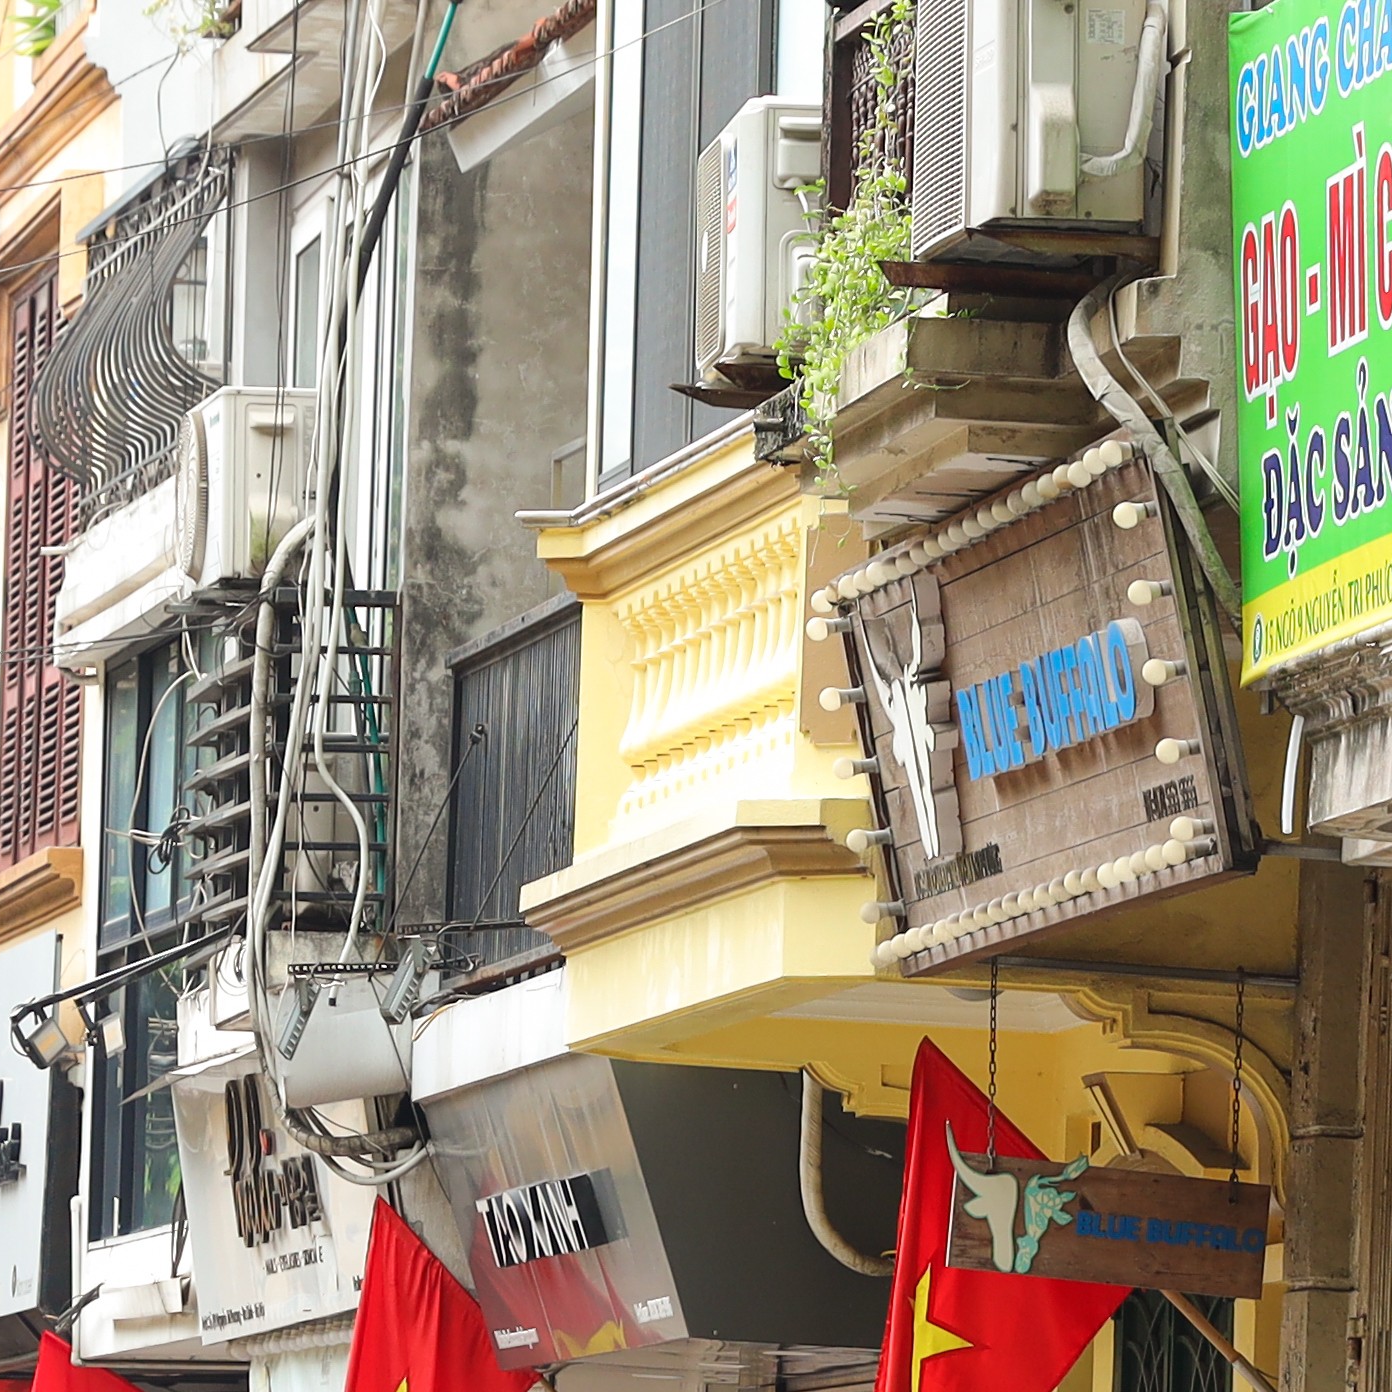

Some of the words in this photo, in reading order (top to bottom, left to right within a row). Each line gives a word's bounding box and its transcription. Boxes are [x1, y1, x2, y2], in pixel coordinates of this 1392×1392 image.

[1236, 16, 1330, 158] GIANG
[1240, 200, 1299, 428] GẠO
[1326, 122, 1368, 356] MÌ
[1261, 403, 1325, 579] ĐẶC
[1348, 577, 1364, 619] TRI
[956, 671, 1025, 781] BLUE
[1019, 621, 1136, 757] BUFFALO
[519, 1178, 589, 1257] XANH
[1076, 1210, 1142, 1242] BLUE
[1146, 1217, 1266, 1254] BUFFALO
